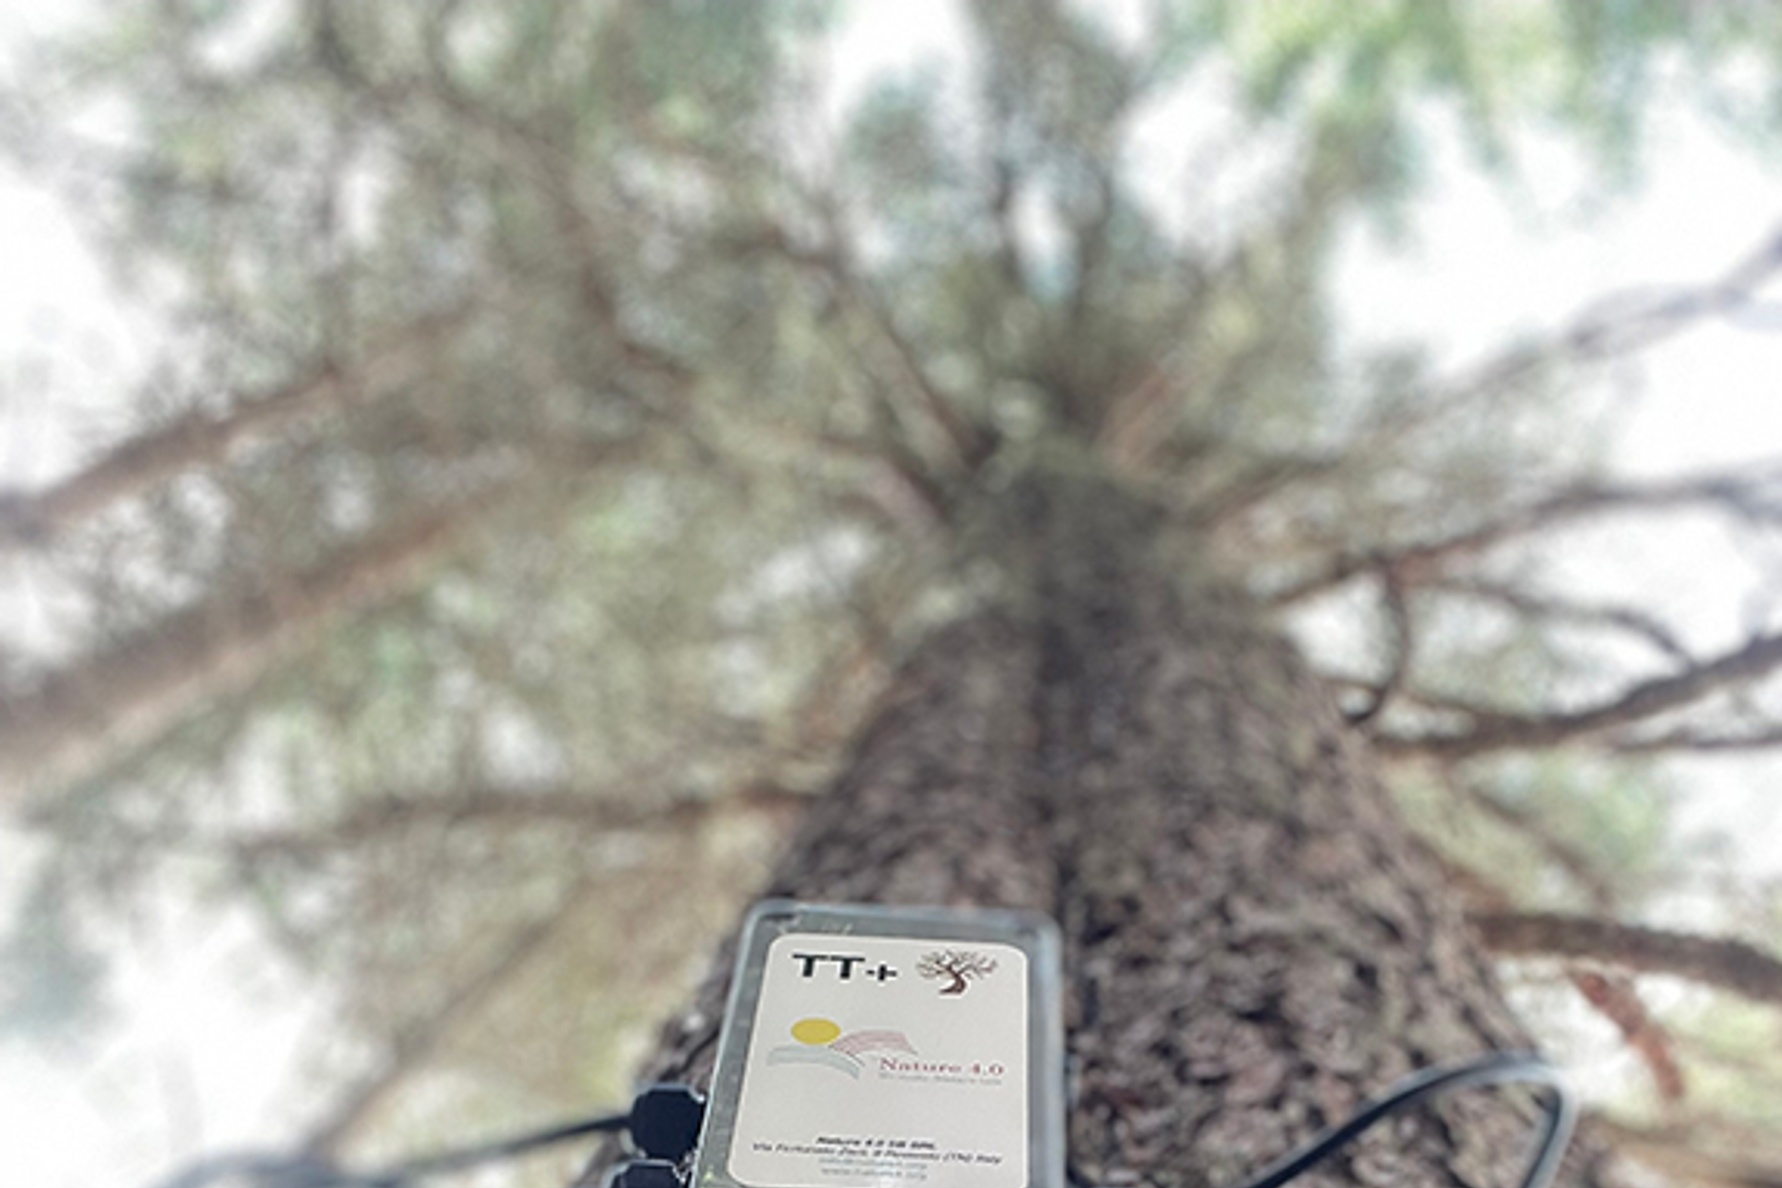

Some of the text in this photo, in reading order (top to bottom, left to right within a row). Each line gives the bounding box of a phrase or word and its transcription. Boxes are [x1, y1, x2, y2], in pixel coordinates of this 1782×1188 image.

[793, 954, 897, 981] TT+
[880, 1058, 1004, 1075] Nature 4.0
